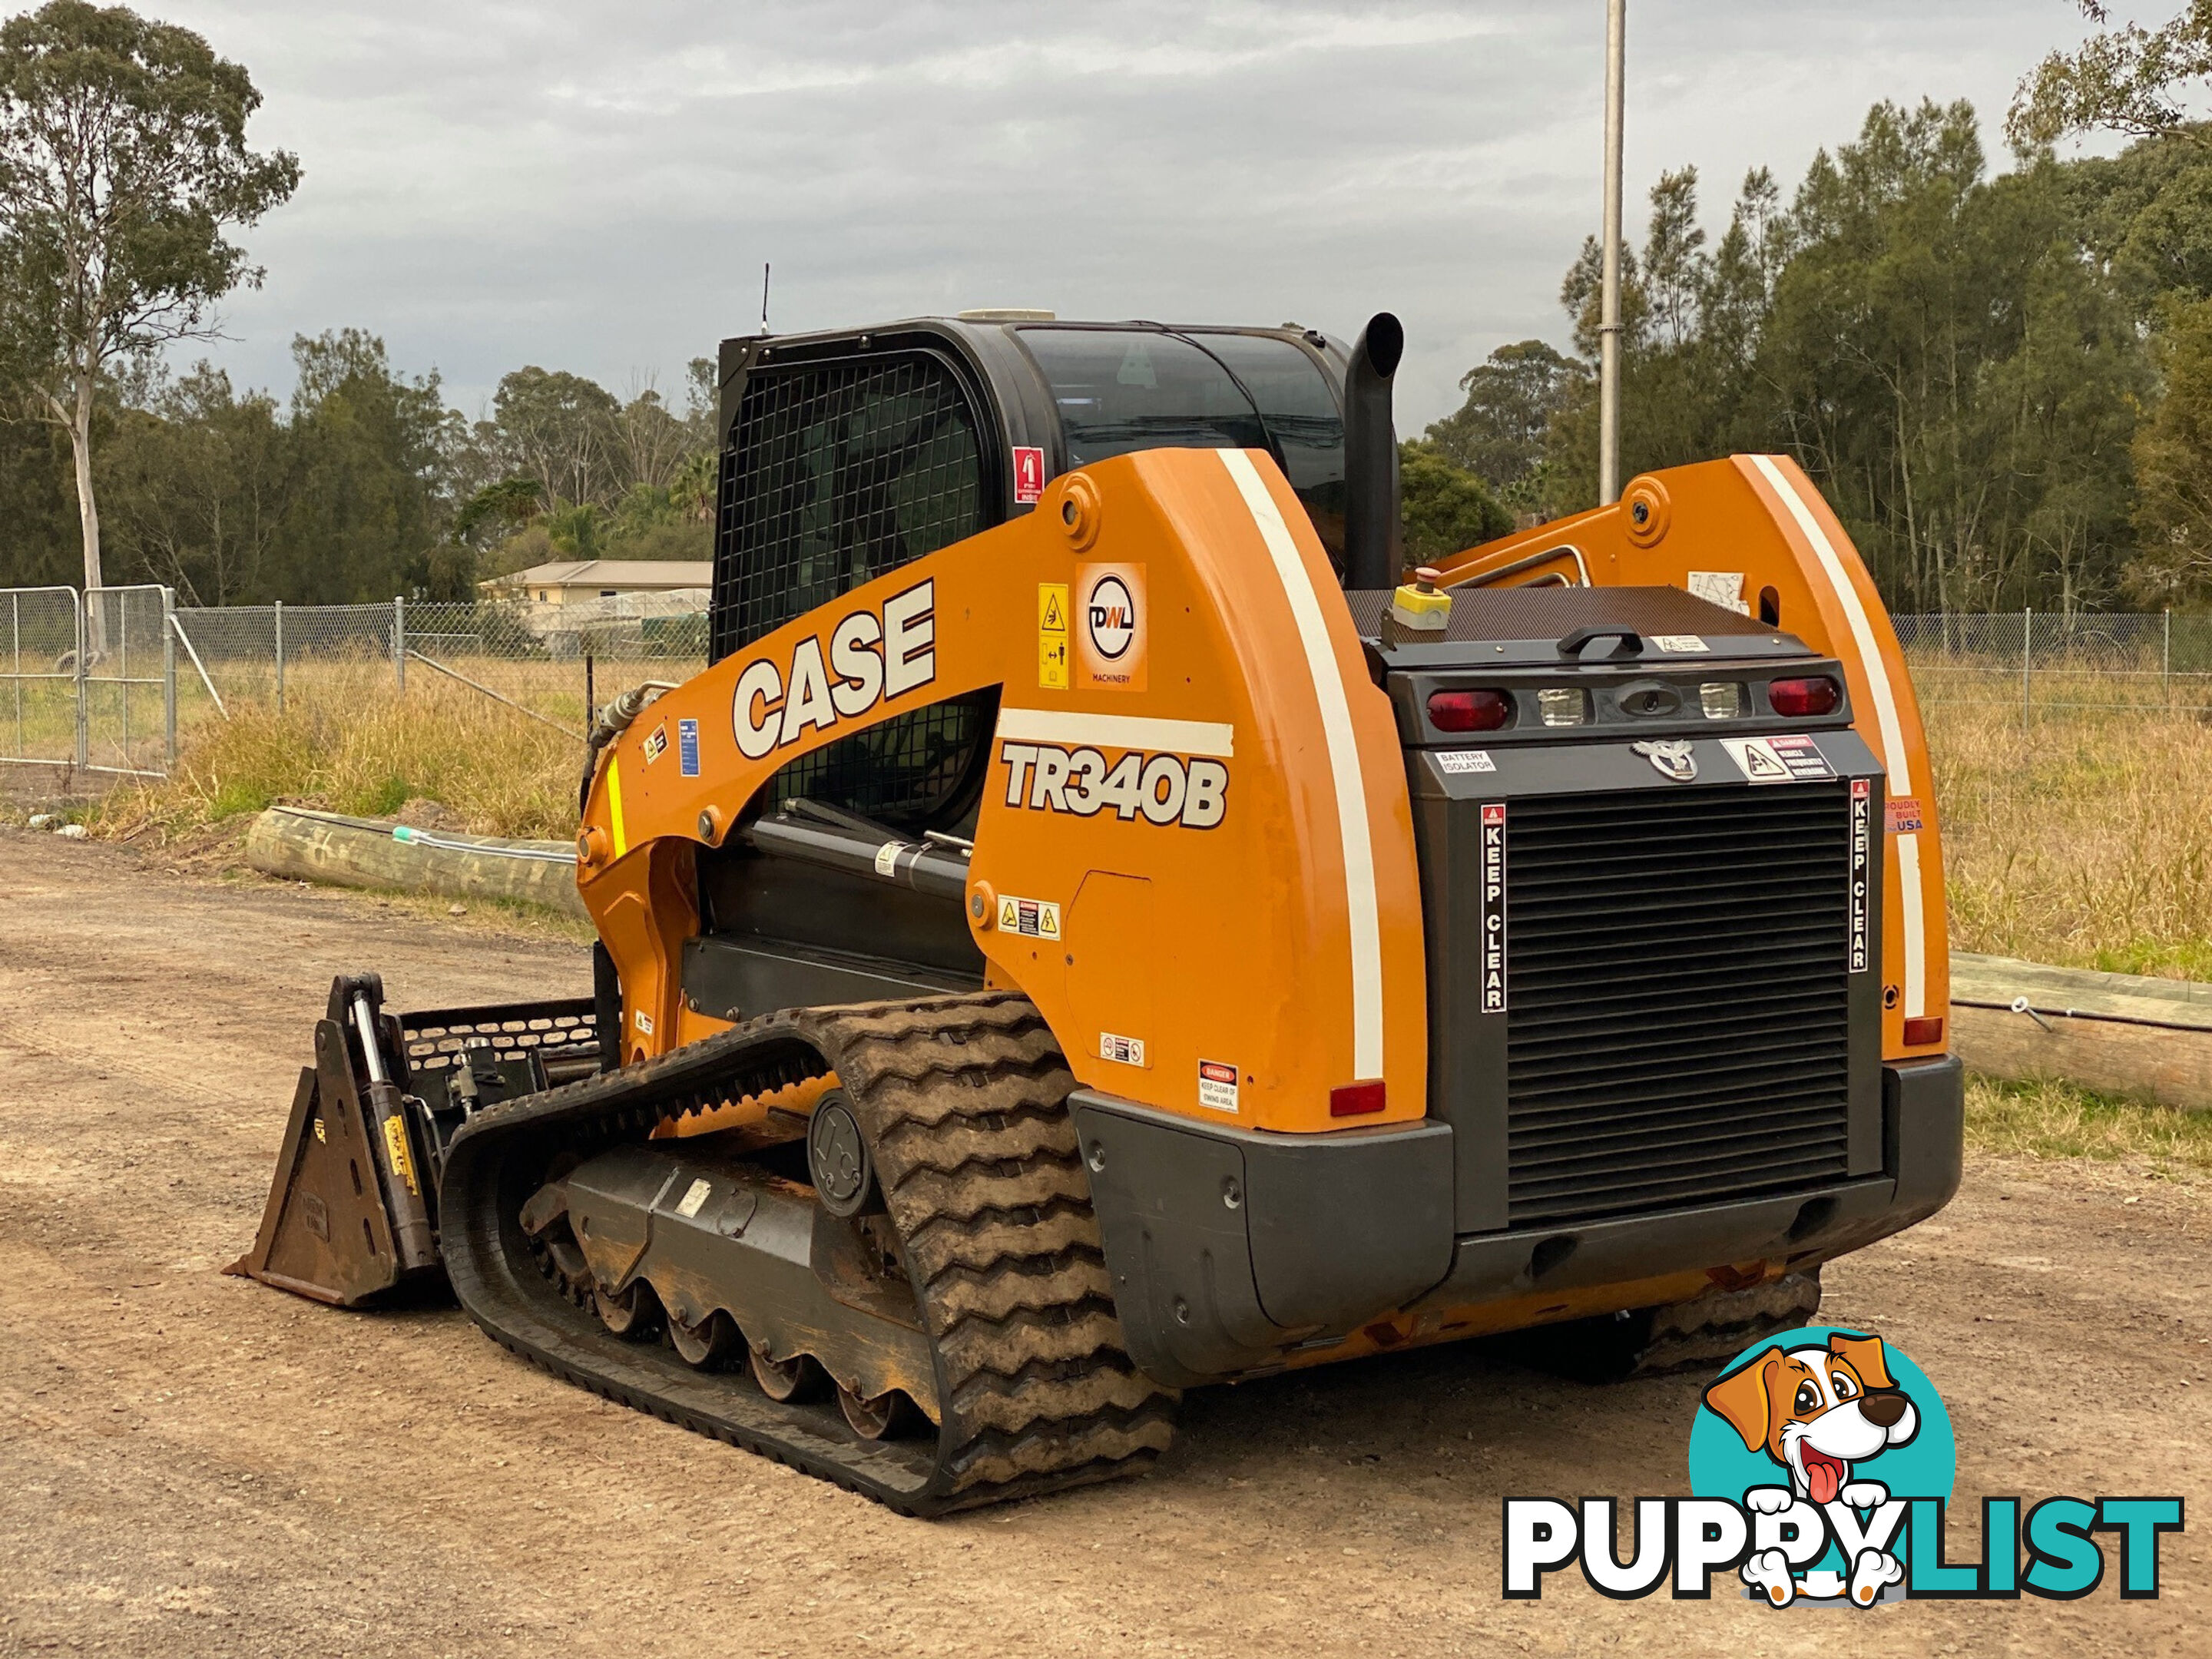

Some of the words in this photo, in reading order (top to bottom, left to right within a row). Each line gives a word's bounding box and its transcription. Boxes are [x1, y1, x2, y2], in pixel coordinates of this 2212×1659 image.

[1089, 607, 1134, 629] DWL
[732, 577, 935, 760] CASE
[1093, 674, 1131, 684] MACHINERY
[1001, 740, 1229, 830] TR340B
[1444, 762, 1492, 770] ISOLATOR
[1886, 800, 1920, 810] ROUDLY
[1896, 810, 1921, 819] BUILT
[1897, 820, 1923, 831] USA
[1854, 801, 1866, 870] KEEP
[1486, 827, 1502, 902] KEEP
[1853, 881, 1865, 968] CLEAR
[1486, 914, 1502, 1008] CLEAR
